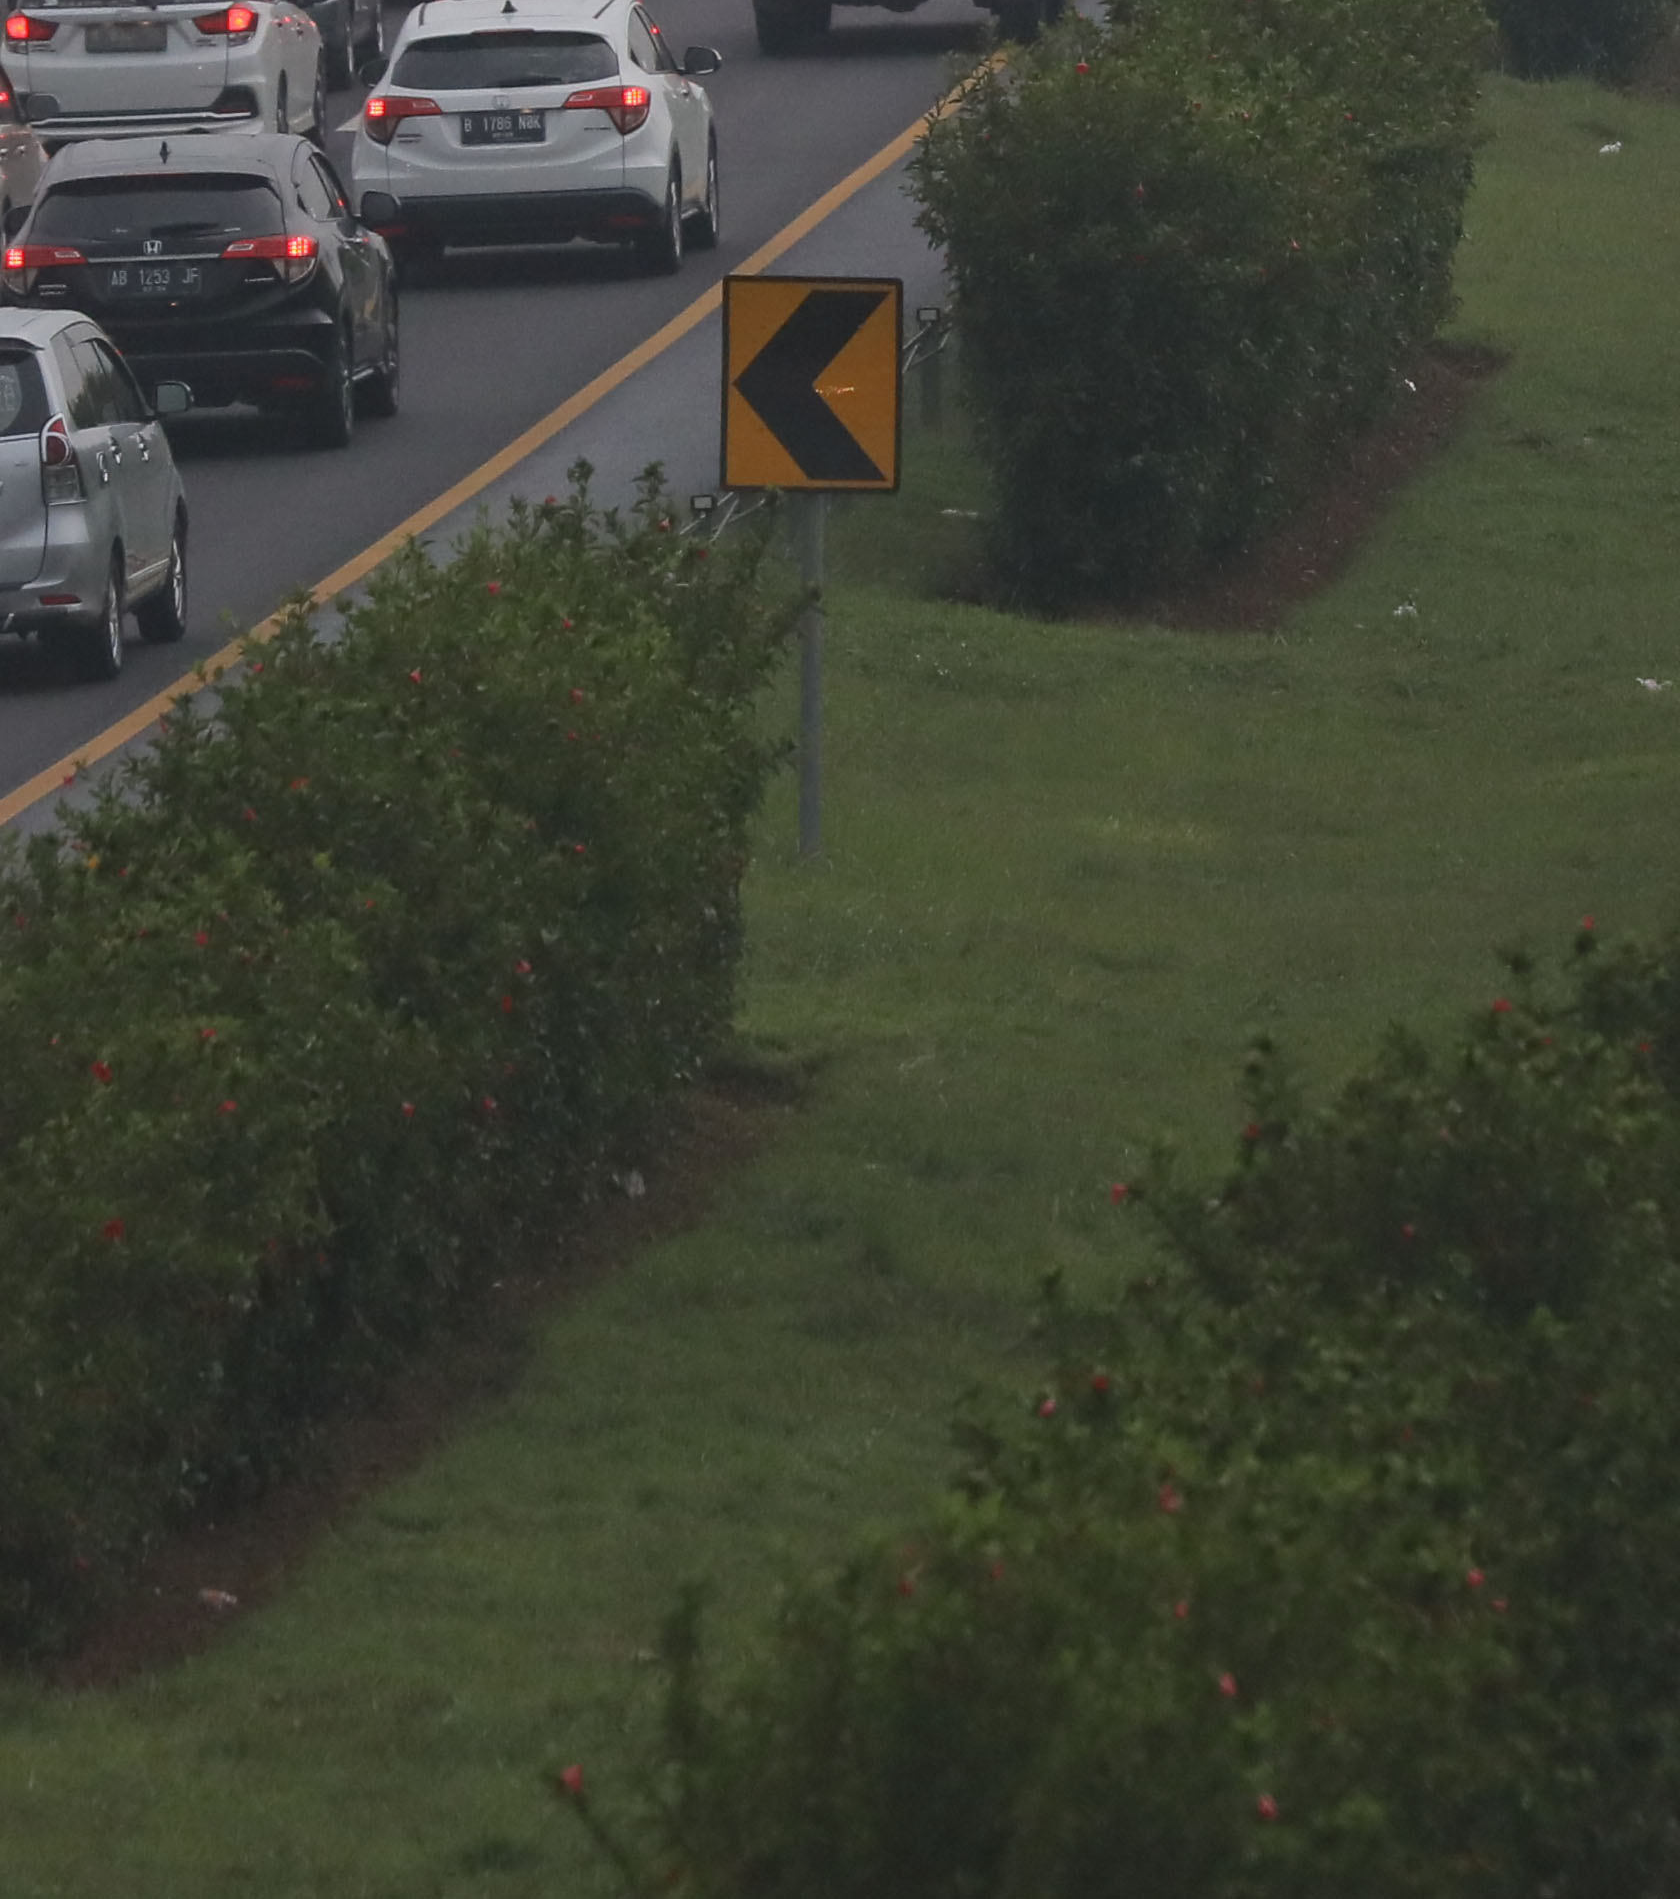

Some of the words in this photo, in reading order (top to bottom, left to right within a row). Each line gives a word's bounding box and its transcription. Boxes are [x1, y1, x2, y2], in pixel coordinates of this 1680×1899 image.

[464, 116, 472, 132] B
[111, 270, 127, 286] AB
[140, 268, 170, 285] 1253
